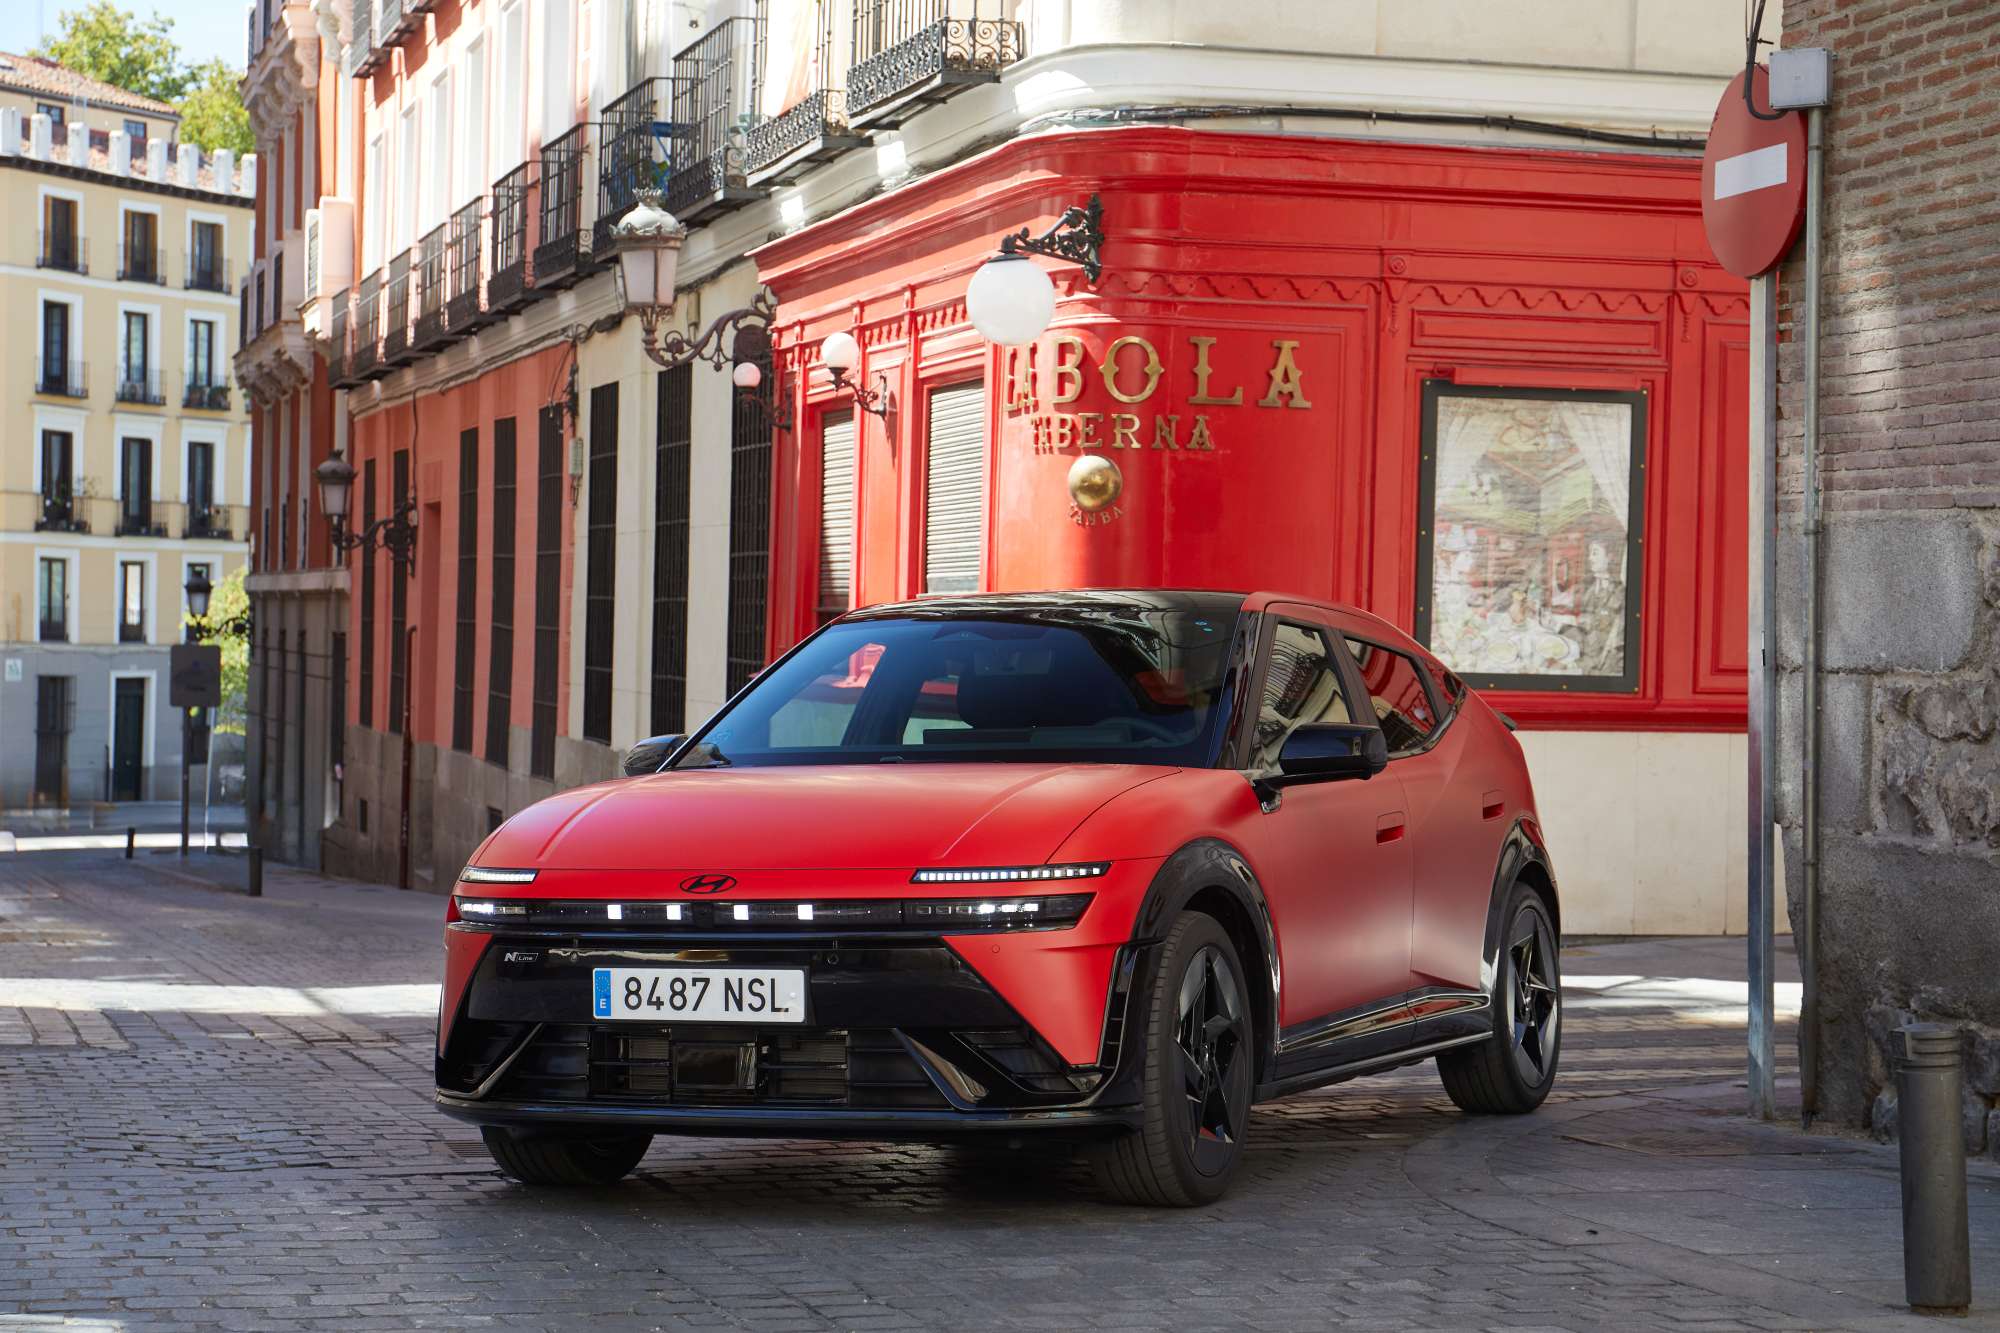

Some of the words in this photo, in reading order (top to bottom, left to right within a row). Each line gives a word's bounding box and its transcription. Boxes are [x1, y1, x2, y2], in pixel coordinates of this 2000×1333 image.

[1003, 341, 1039, 412] LA
[1049, 335, 1312, 409] BOLA
[1030, 412, 1214, 450] TABERNA
[504, 951, 518, 962] N
[600, 998, 607, 1009] E
[624, 976, 711, 1012] 8487
[724, 977, 789, 1013] NSL
